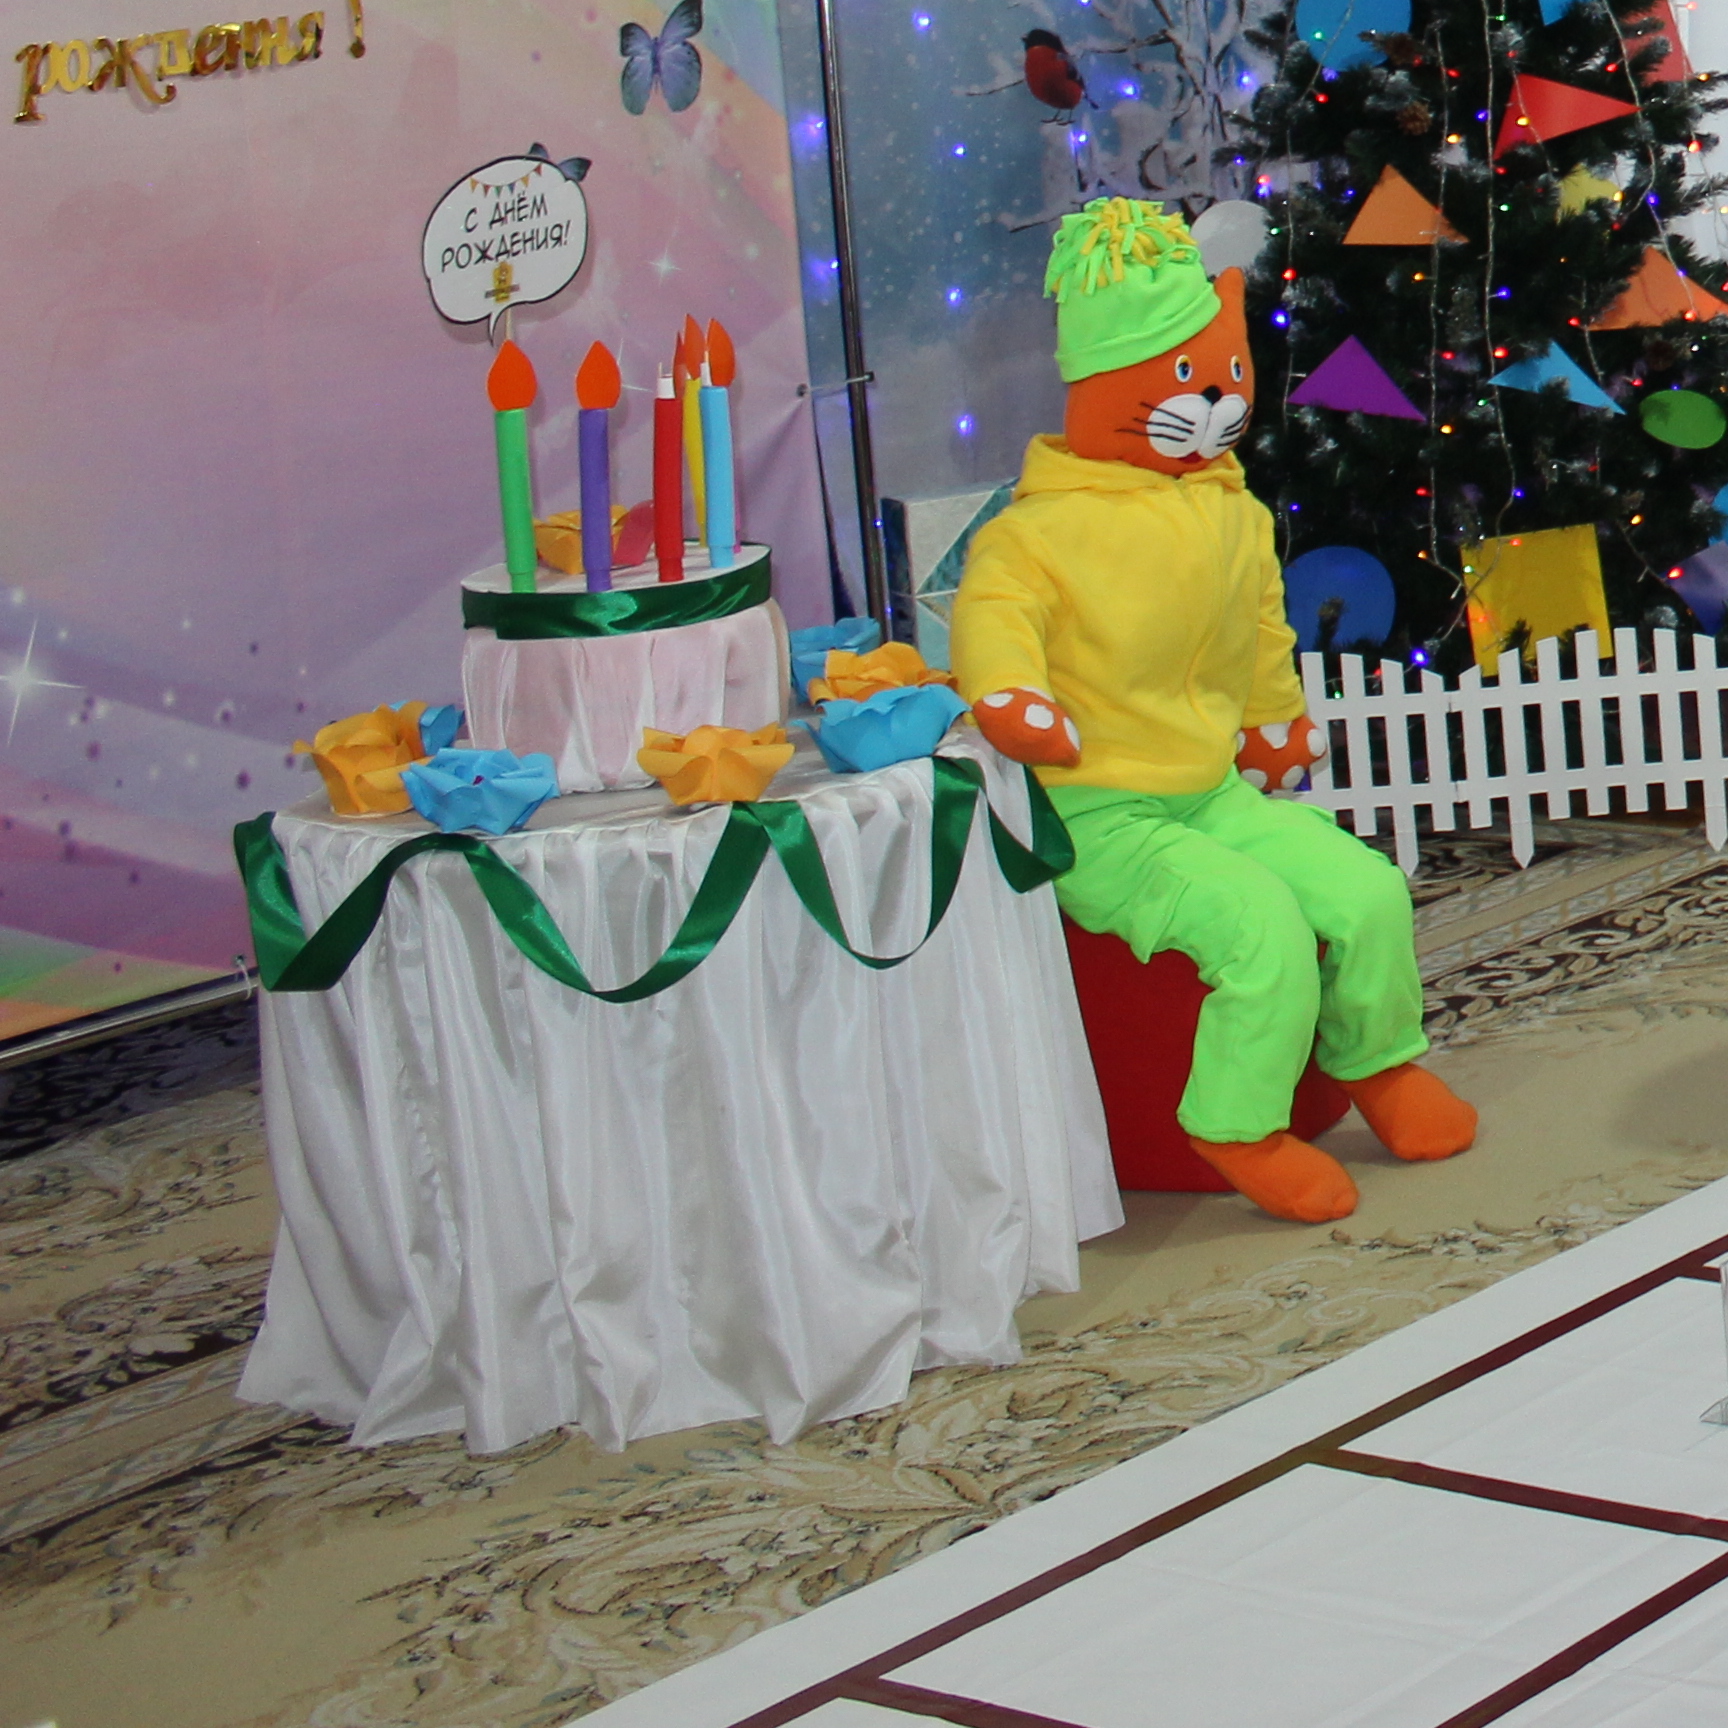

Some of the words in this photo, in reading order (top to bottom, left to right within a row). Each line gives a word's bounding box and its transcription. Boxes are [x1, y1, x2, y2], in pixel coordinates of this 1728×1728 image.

[463, 206, 478, 233] С
[489, 190, 548, 230] ДНЁМ
[440, 219, 571, 273] РОЖДЕНИЯ!
